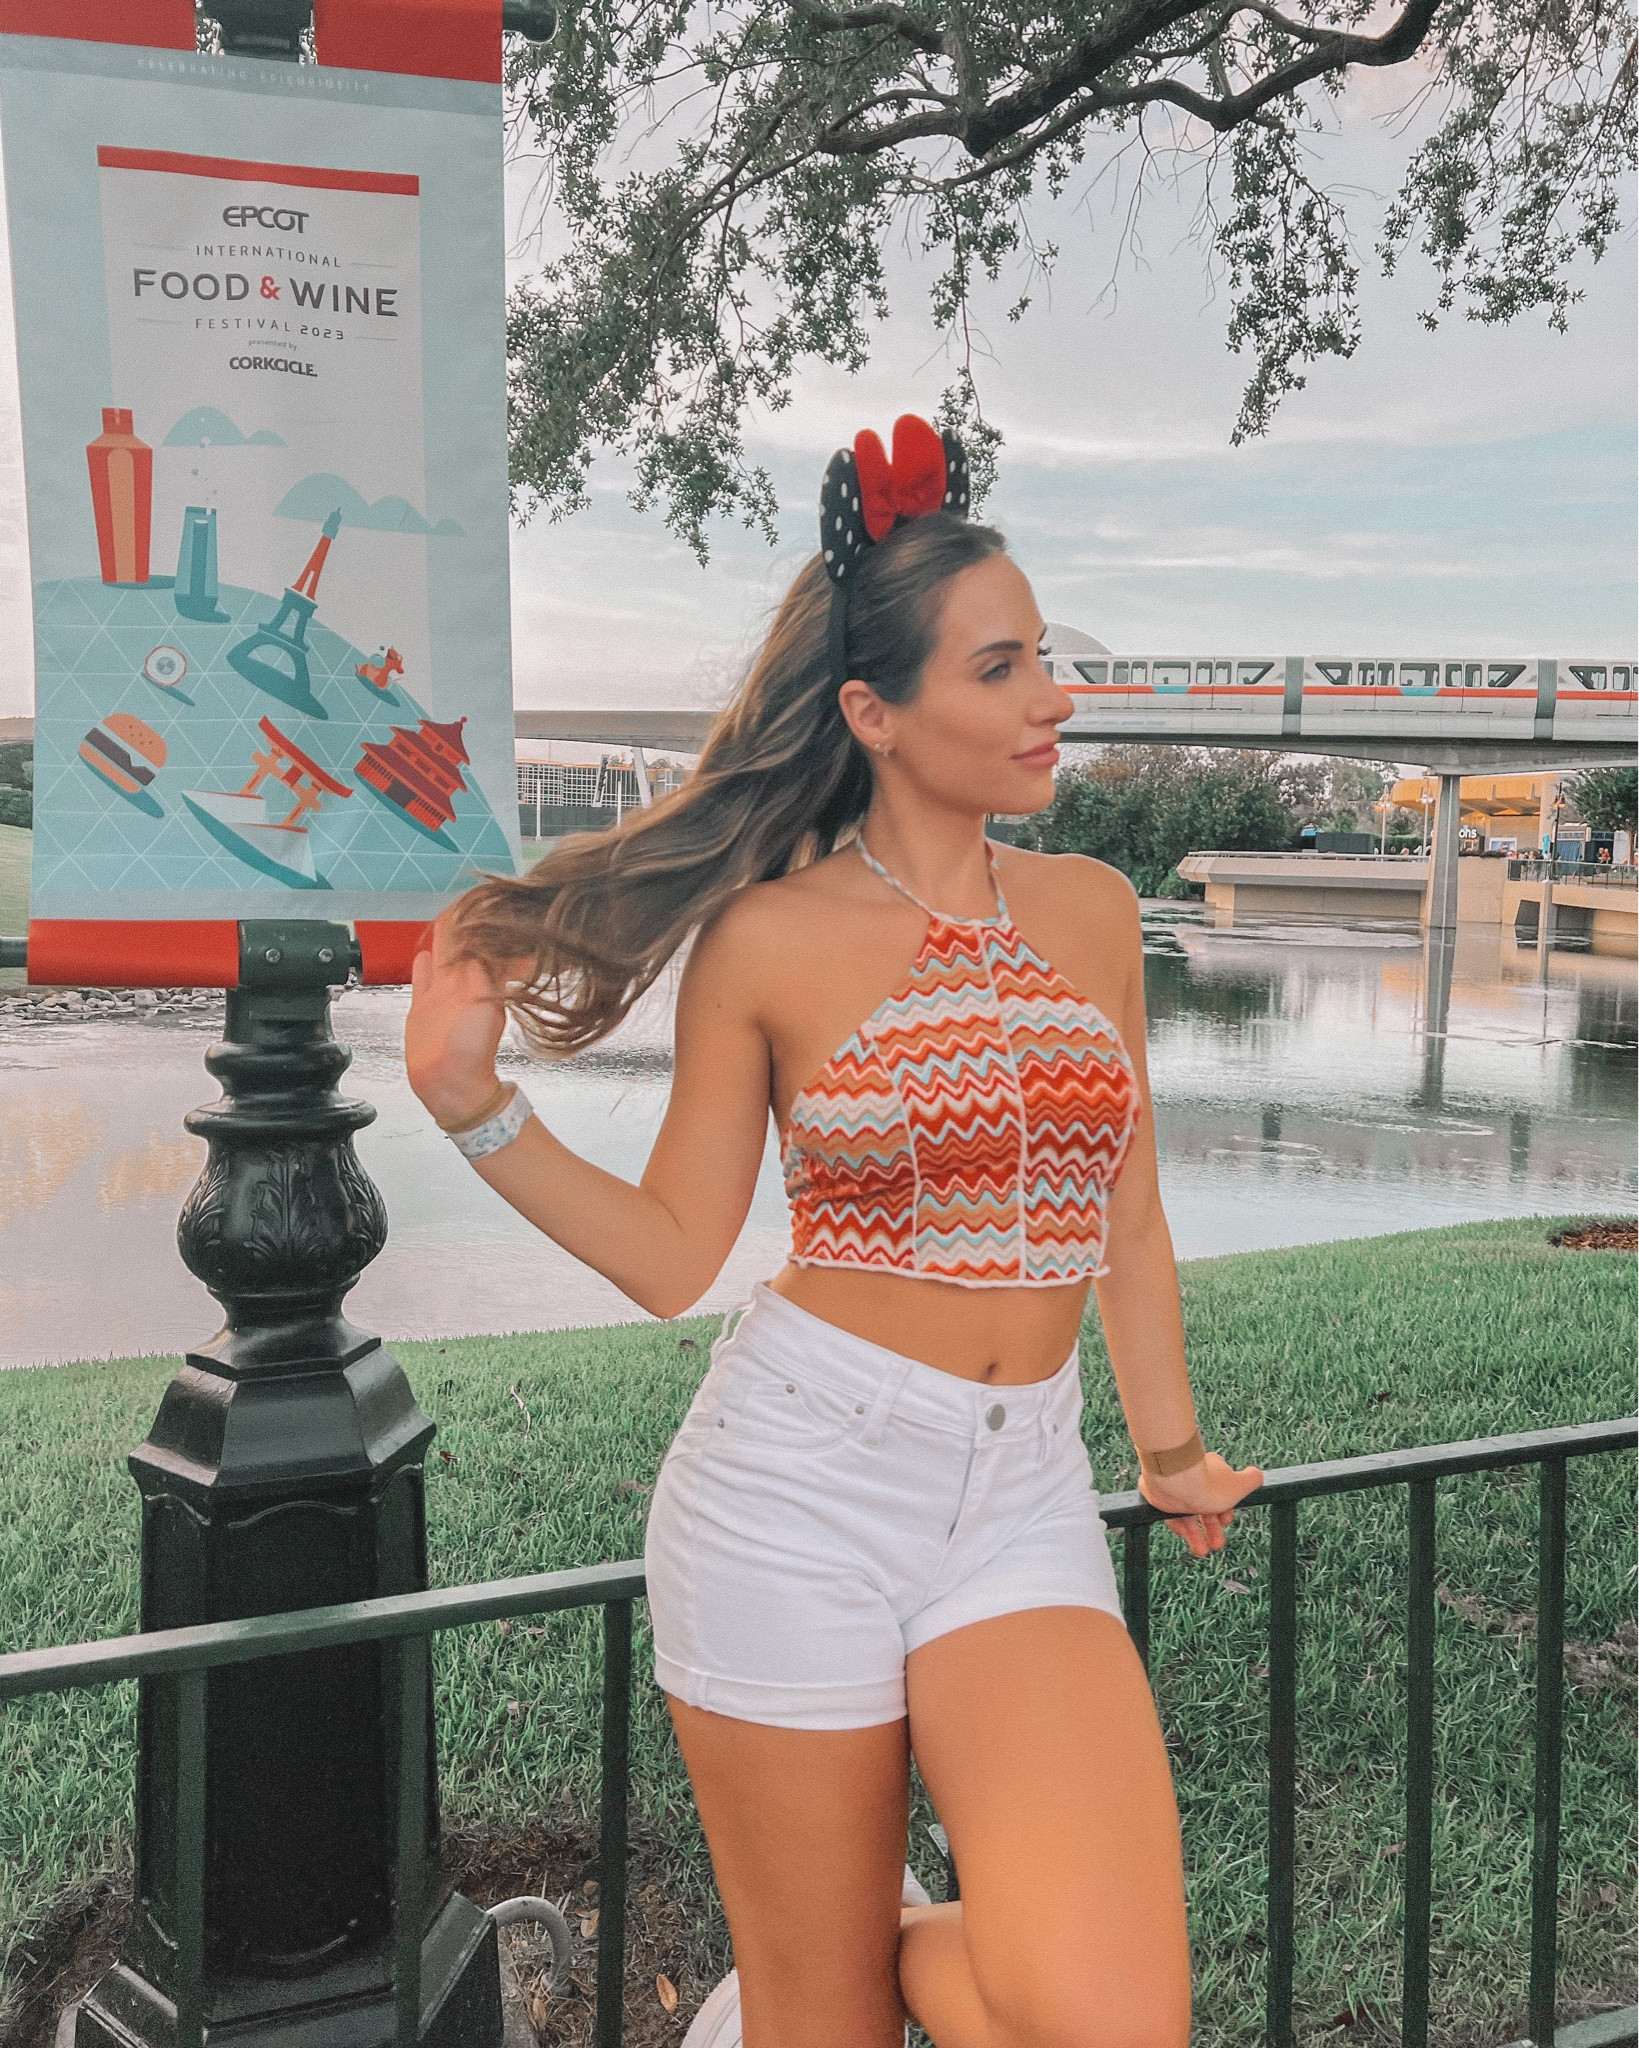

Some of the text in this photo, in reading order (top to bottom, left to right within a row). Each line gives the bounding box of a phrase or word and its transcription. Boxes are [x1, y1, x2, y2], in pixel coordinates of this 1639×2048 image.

[222, 205, 310, 234] EPCOT
[196, 244, 341, 268] INTERNATIONAL
[133, 267, 399, 317] FOOD & WINE
[195, 317, 344, 340] FESTIVAL 2023
[248, 339, 297, 351] presented by
